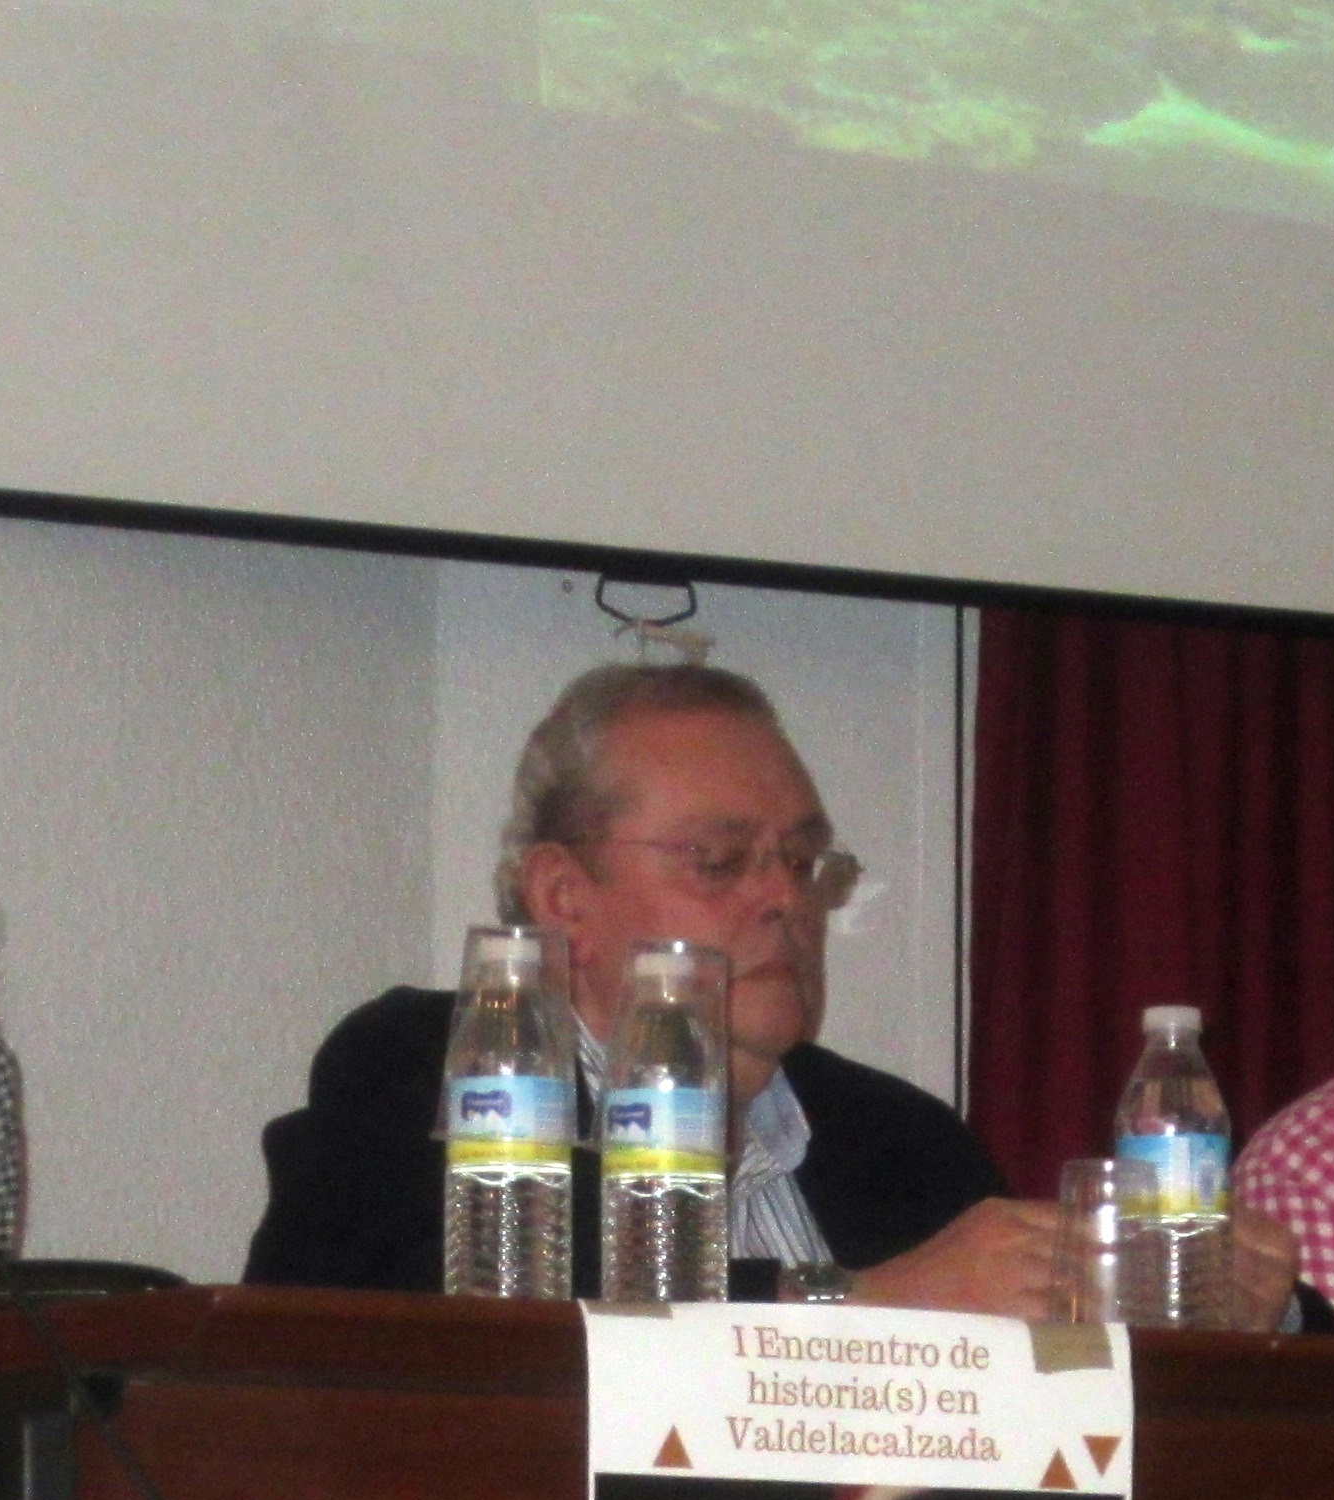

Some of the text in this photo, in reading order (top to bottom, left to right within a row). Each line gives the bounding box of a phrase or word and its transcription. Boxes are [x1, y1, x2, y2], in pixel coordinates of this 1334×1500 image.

[733, 1325, 991, 1370] I Encuentro de
[747, 1371, 981, 1415] historia(s) en
[725, 1415, 1002, 1462] Valdelacalzada
